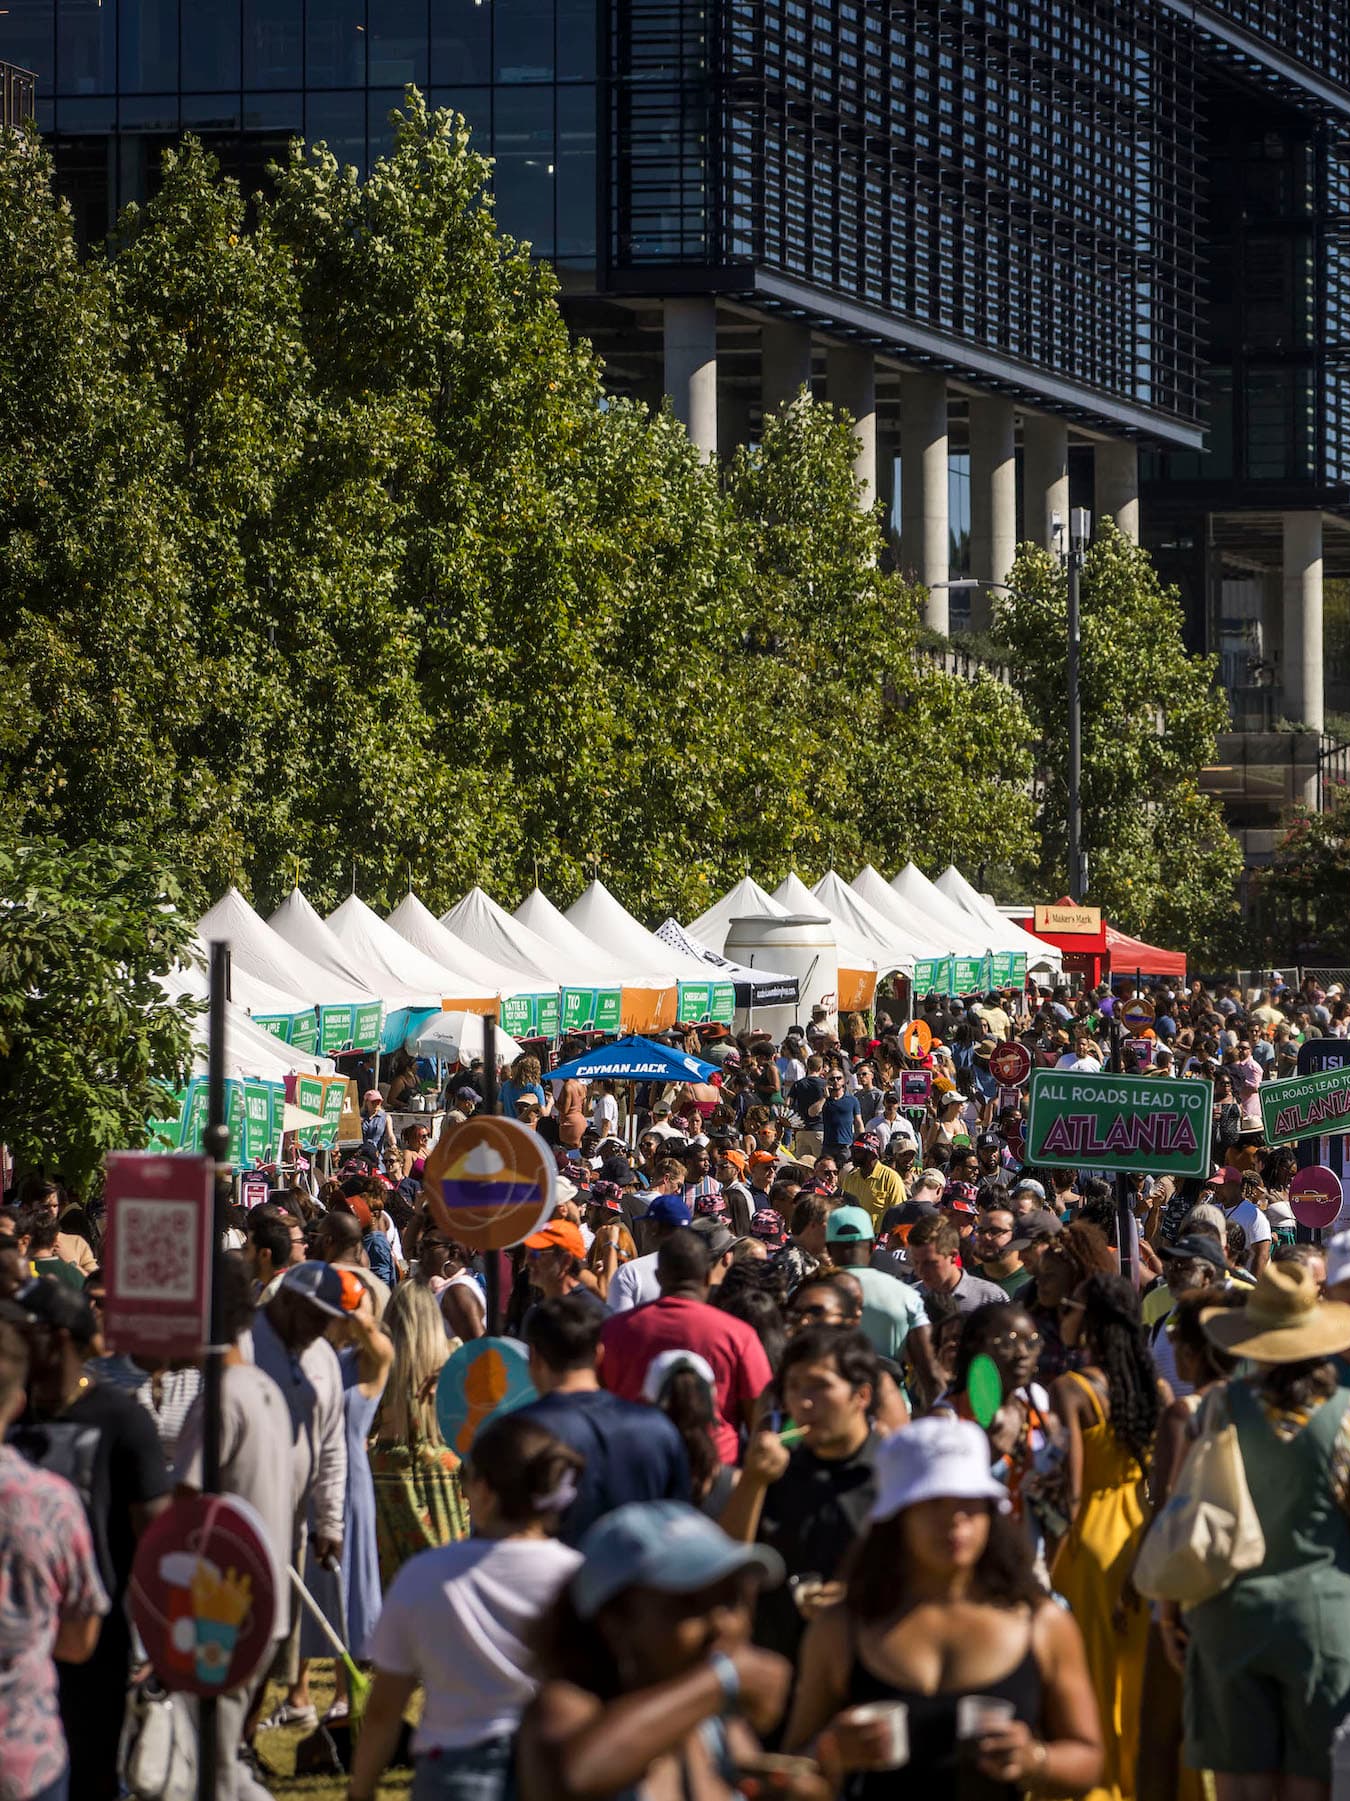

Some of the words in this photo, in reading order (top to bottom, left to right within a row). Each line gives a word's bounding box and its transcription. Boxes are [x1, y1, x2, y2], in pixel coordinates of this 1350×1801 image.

[1052, 913, 1075, 924] Maker's
[1075, 913, 1093, 924] Mark
[576, 1064, 630, 1077] CAYMAN
[1039, 1085, 1067, 1100] ALL
[1072, 1086, 1128, 1105] ROADS
[1133, 1091, 1174, 1108] LEAD
[1180, 1093, 1201, 1110] TO
[1264, 1092, 1281, 1105] ALL
[1282, 1084, 1314, 1100] ROADS
[1316, 1079, 1341, 1093] LEAD
[1041, 1112, 1198, 1155] ATLANTA
